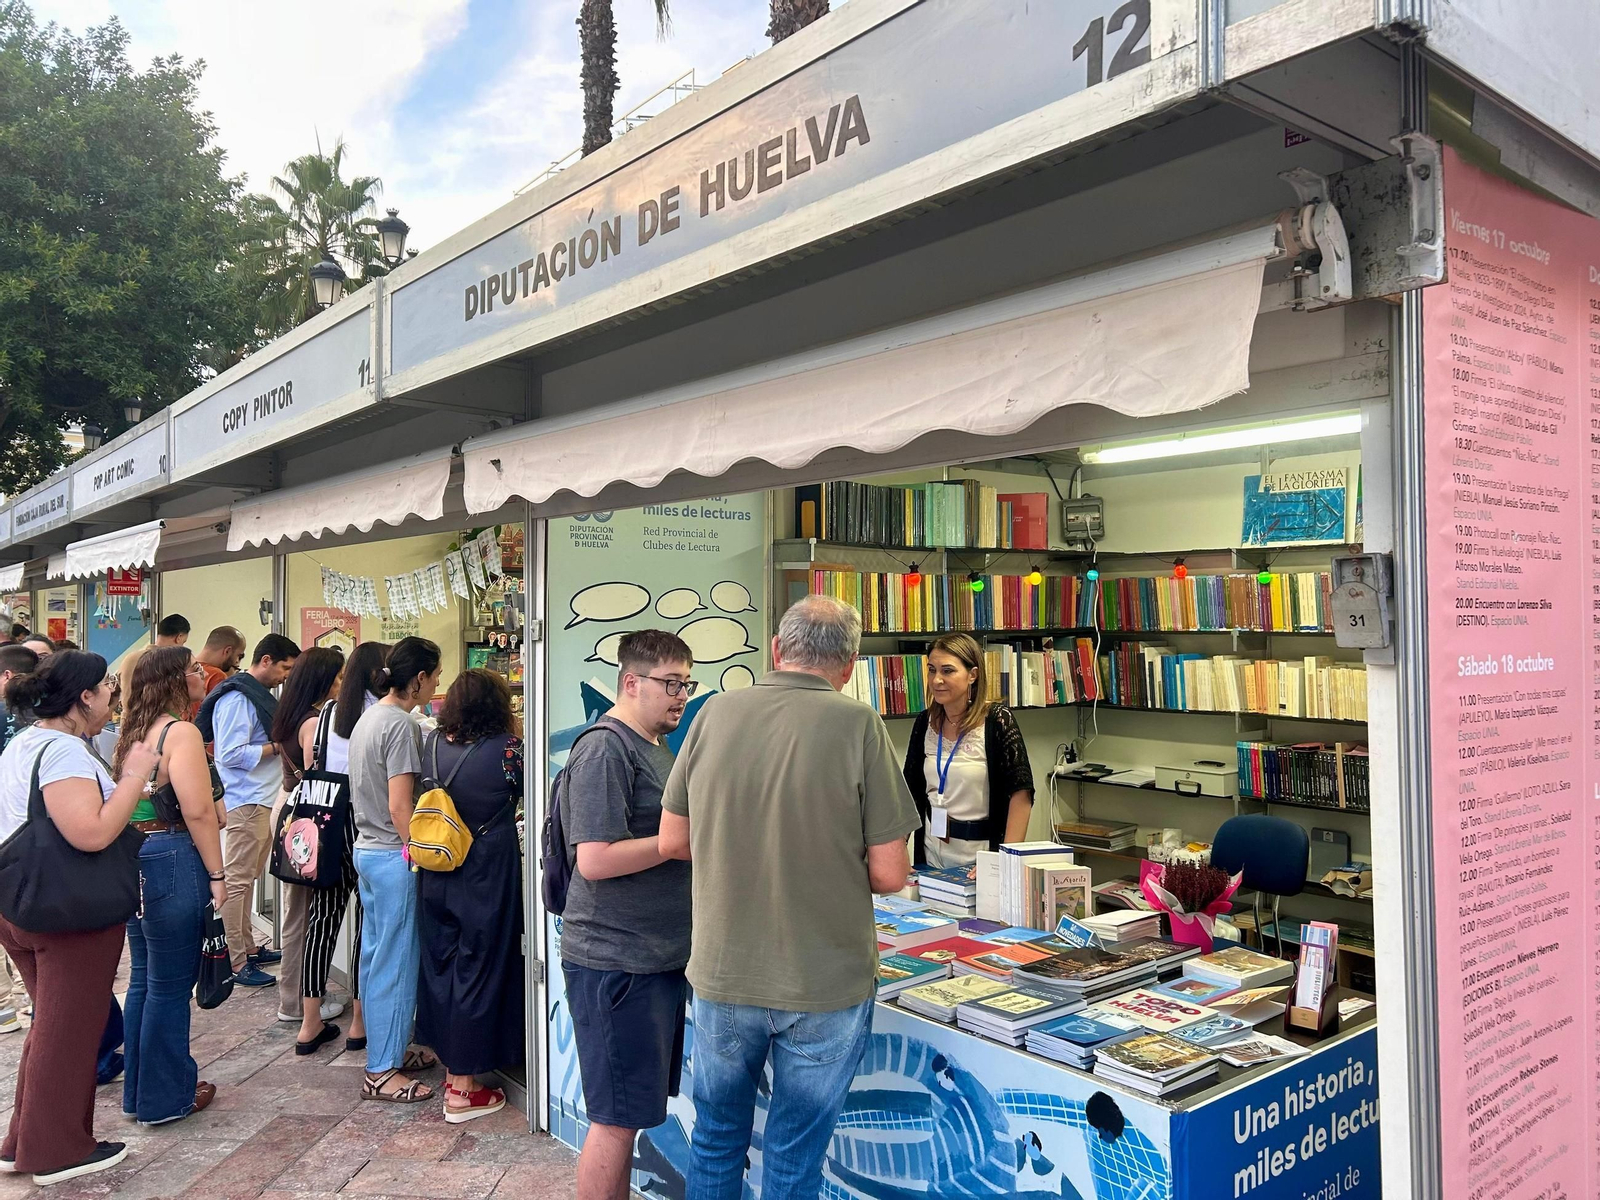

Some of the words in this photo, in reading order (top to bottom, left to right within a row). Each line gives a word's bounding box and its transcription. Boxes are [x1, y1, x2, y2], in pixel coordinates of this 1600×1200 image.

[1072, 0, 1152, 88] 12
[463, 208, 622, 321] DIPUTACIÓN
[637, 185, 681, 247] DE
[699, 94, 871, 218] HUELVA
[1450, 208, 1490, 243] Viernes
[1493, 230, 1505, 249] 17
[1510, 240, 1550, 265] octubre
[1503, 317, 1511, 327] de
[1512, 319, 1522, 331] Paz
[1450, 333, 1468, 347] 18.00
[1452, 368, 1470, 382] 18.00
[1471, 373, 1487, 386] Firma
[222, 402, 249, 434] COPY
[253, 380, 293, 421] PINTOR
[358, 358, 371, 388] 11
[1525, 419, 1540, 432] David
[1541, 421, 1548, 433] de
[1550, 422, 1558, 434] Gil
[1455, 437, 1472, 451] 18.30
[93, 474, 103, 492] POP
[103, 467, 115, 488] ART
[116, 457, 135, 481] COMIC
[158, 454, 167, 475] 10
[1284, 470, 1344, 481] FANTASMA
[1291, 478, 1344, 489] GLORIETA
[1453, 473, 1471, 485] 19.00
[1472, 475, 1507, 490] Presentación
[1537, 486, 1544, 495] de
[1482, 494, 1503, 507] Manuel
[1504, 497, 1518, 509] Jesús
[643, 504, 678, 517] miles
[682, 505, 697, 518] de
[700, 506, 751, 521] lecturas
[1454, 507, 1476, 520] Espacio
[570, 525, 614, 534] DIPUTACIÓN
[644, 527, 660, 536] Red
[663, 528, 706, 538] Provincial
[708, 529, 719, 539] de
[1455, 525, 1472, 536] 19.00
[1474, 526, 1499, 540] Photocall
[1500, 531, 1510, 540] con
[570, 533, 613, 541] PROVINCIAL
[643, 540, 673, 551] Clubes
[675, 542, 686, 551] de
[688, 543, 720, 552] Lectura
[1455, 543, 1472, 554] 19.00
[1474, 544, 1489, 556] Firma
[1552, 551, 1561, 561] Luis
[1455, 560, 1478, 572] Alfonso
[1479, 561, 1502, 573] Morales
[1503, 563, 1523, 574] Mateo.
[1457, 577, 1474, 589] Stand
[1475, 578, 1499, 590] Editorial
[1456, 598, 1474, 609] 20.00
[1475, 598, 1504, 609] Encuentro
[1506, 601, 1516, 609] con
[1517, 599, 1539, 609] Lorenzo
[1540, 599, 1552, 609] Silva
[306, 611, 329, 619] FERIA
[1350, 614, 1365, 627] 31
[1491, 615, 1512, 628] Espacio
[321, 619, 344, 627] LIBRO
[1458, 654, 1498, 677] Sábado
[1501, 654, 1514, 673] 18
[1516, 652, 1554, 673] octubre
[1459, 694, 1476, 707] 11.00
[1478, 693, 1513, 705] Presentación
[1494, 708, 1510, 720] María
[1458, 729, 1482, 744] Espacio
[1459, 747, 1475, 760] 12.00
[1459, 799, 1475, 812] 12.00
[1476, 797, 1493, 809] Firma
[1460, 817, 1469, 830] del
[1461, 834, 1477, 848] 12.00
[1459, 869, 1477, 883] 12.00
[1459, 921, 1475, 936] 13.00
[1059, 926, 1085, 946] NOVEDADES
[1517, 951, 1536, 964] Nieves
[1537, 942, 1559, 955] Herrero
[1133, 993, 1201, 1015] TODO
[1137, 1003, 1169, 1014] POR
[1109, 1000, 1181, 1023] HUELVA
[1234, 1101, 1280, 1144] Una
[1285, 1058, 1373, 1120] historia,
[1234, 1144, 1296, 1198] miles
[1300, 1124, 1327, 1161] de
[1331, 1098, 1381, 1144] lectu
[1303, 1172, 1341, 1200] cial
[1344, 1165, 1360, 1191] de
